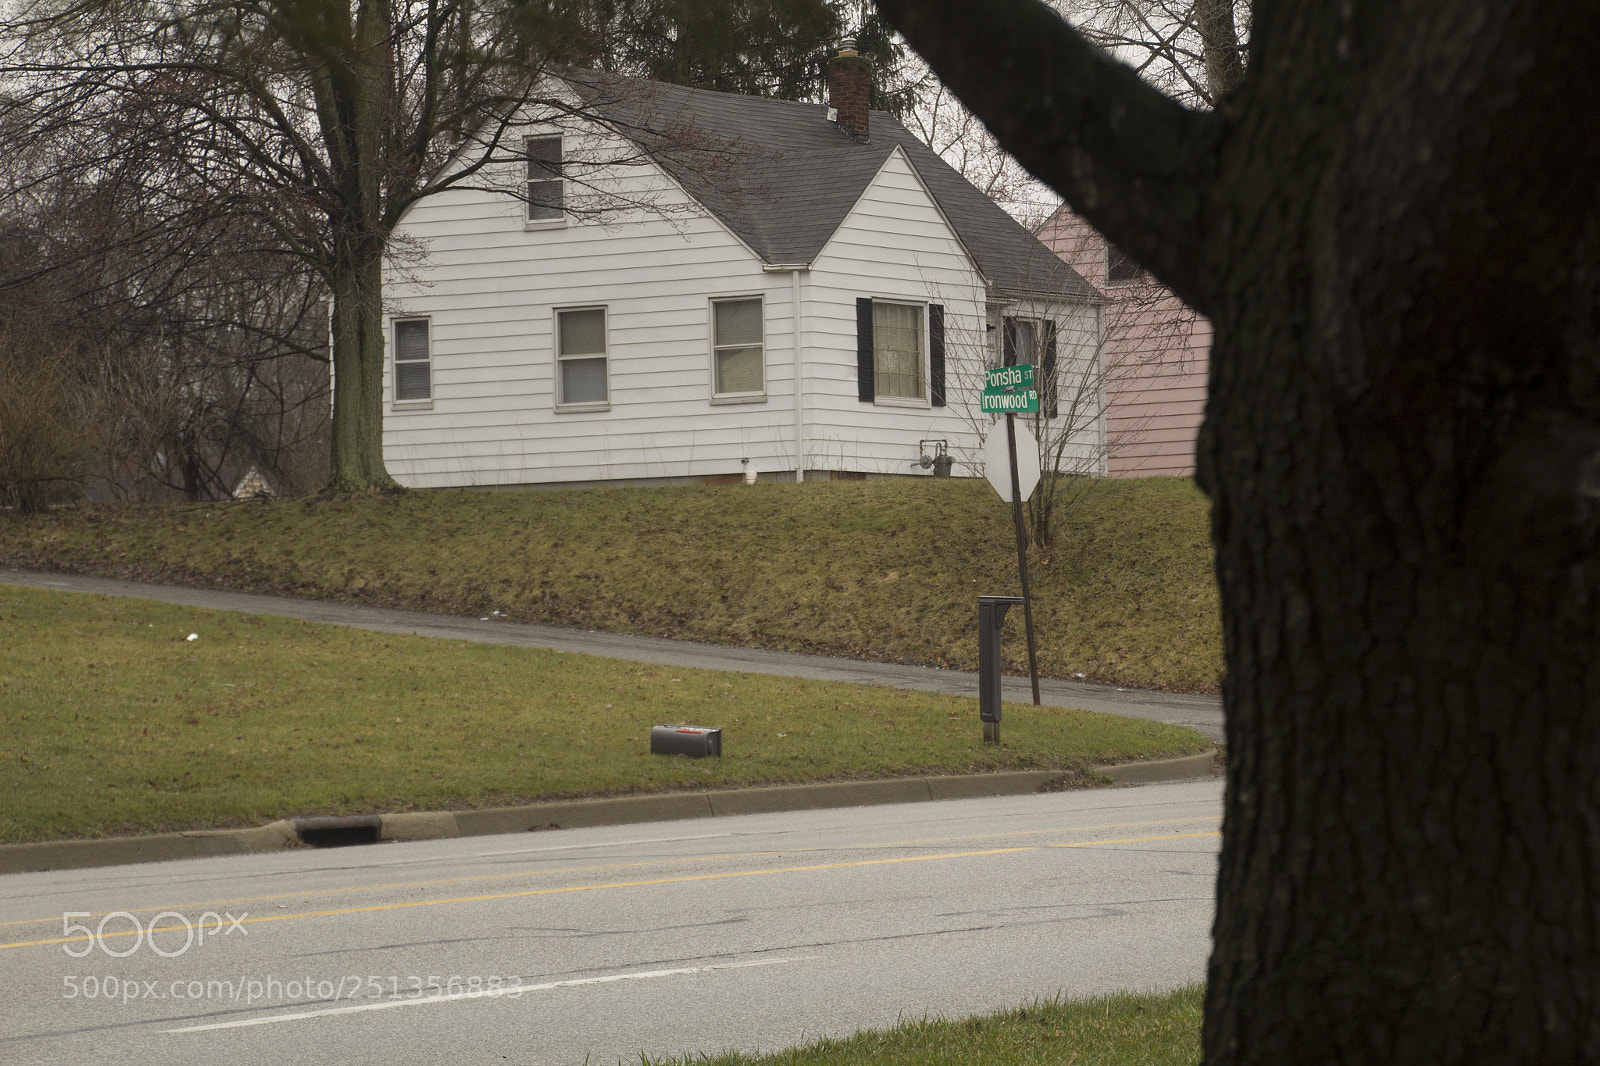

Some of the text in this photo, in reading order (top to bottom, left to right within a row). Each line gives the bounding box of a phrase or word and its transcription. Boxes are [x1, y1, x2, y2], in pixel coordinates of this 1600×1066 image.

[984, 367, 1033, 388] Ponsha ST
[982, 390, 1038, 409] Ironwood RD
